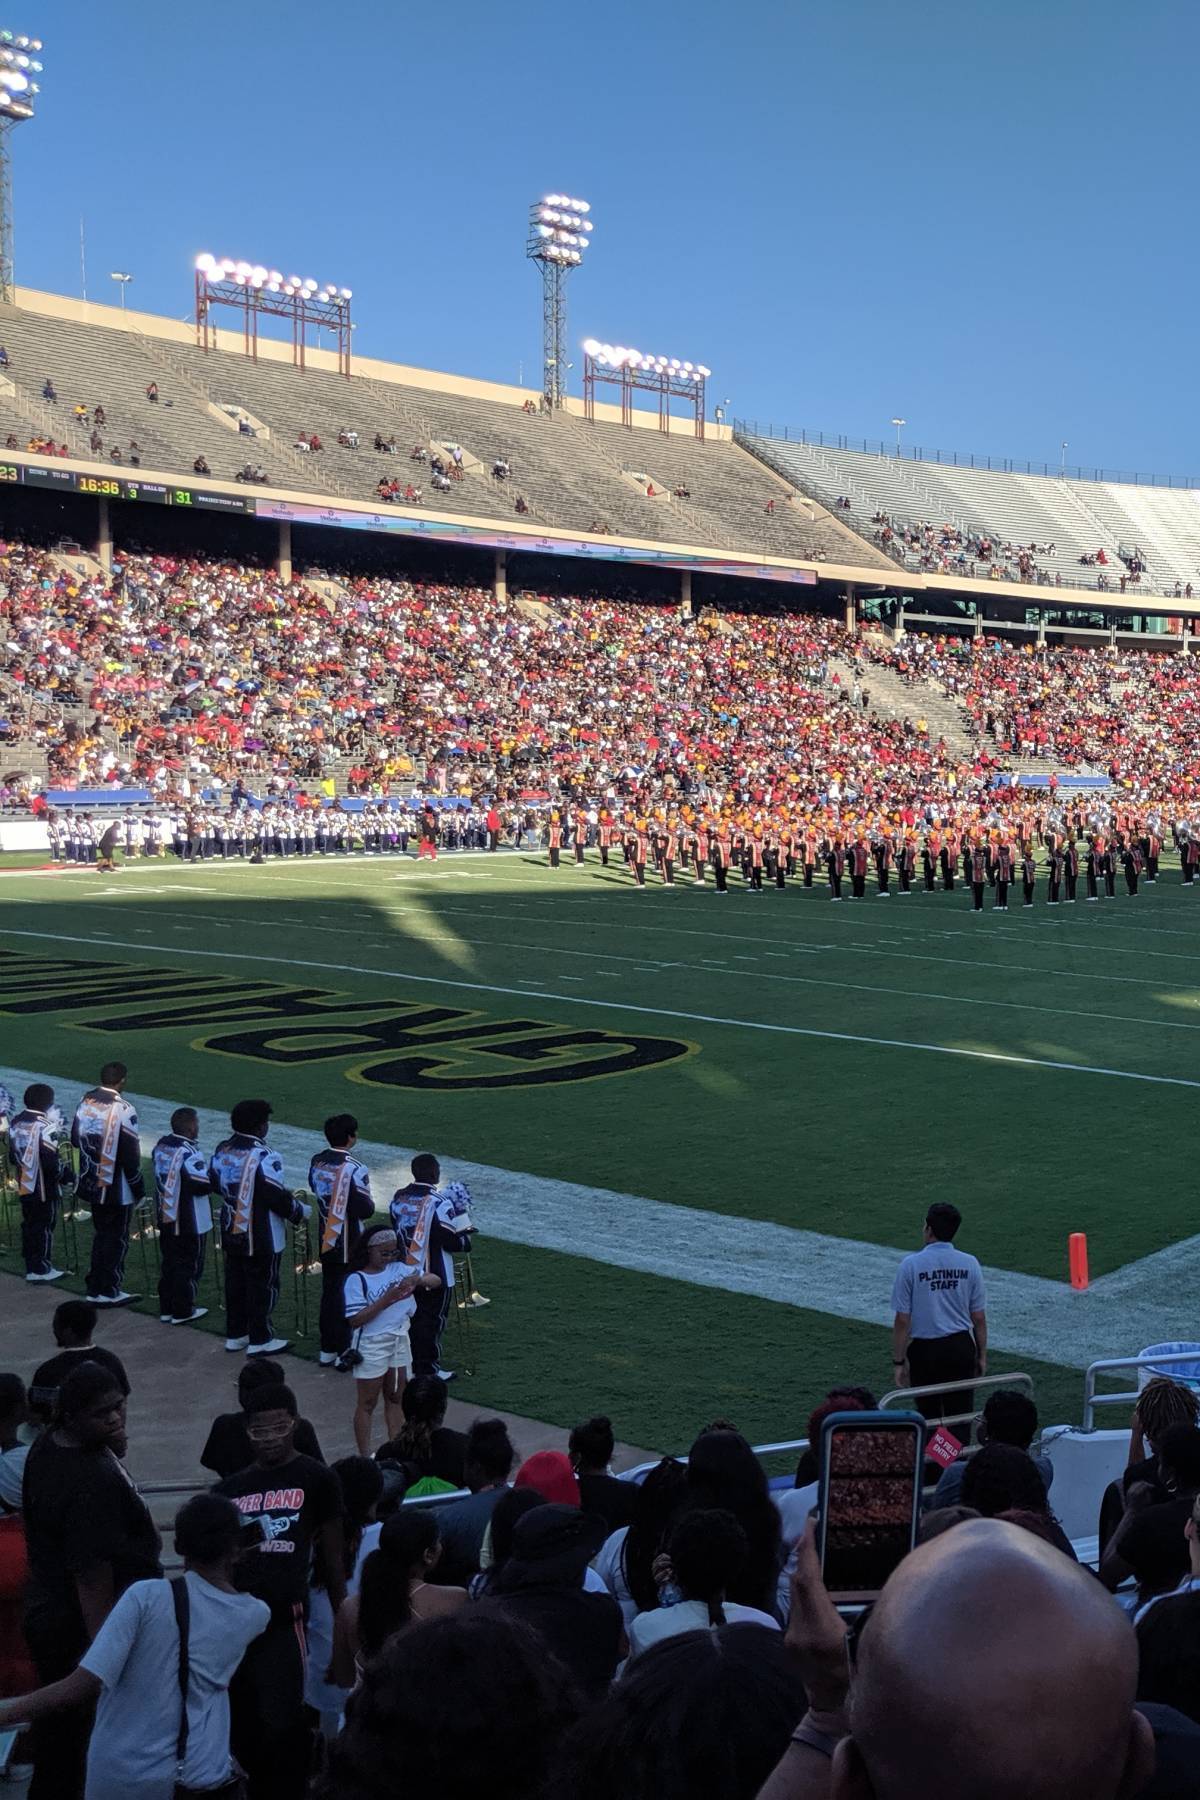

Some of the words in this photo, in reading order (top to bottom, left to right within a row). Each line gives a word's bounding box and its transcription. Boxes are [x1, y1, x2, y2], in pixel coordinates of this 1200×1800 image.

[0, 465, 17, 480] 23
[80, 477, 119, 494] 16:36
[130, 489, 137, 498] 3
[176, 490, 192, 504] 31
[919, 1269, 968, 1282] PLATINUM
[930, 1280, 958, 1291] STAFF
[932, 1445, 950, 1460] ENTRY
[934, 1433, 944, 1444] NO
[943, 1441, 958, 1457] FIELD
[263, 1488, 304, 1510] BAND
